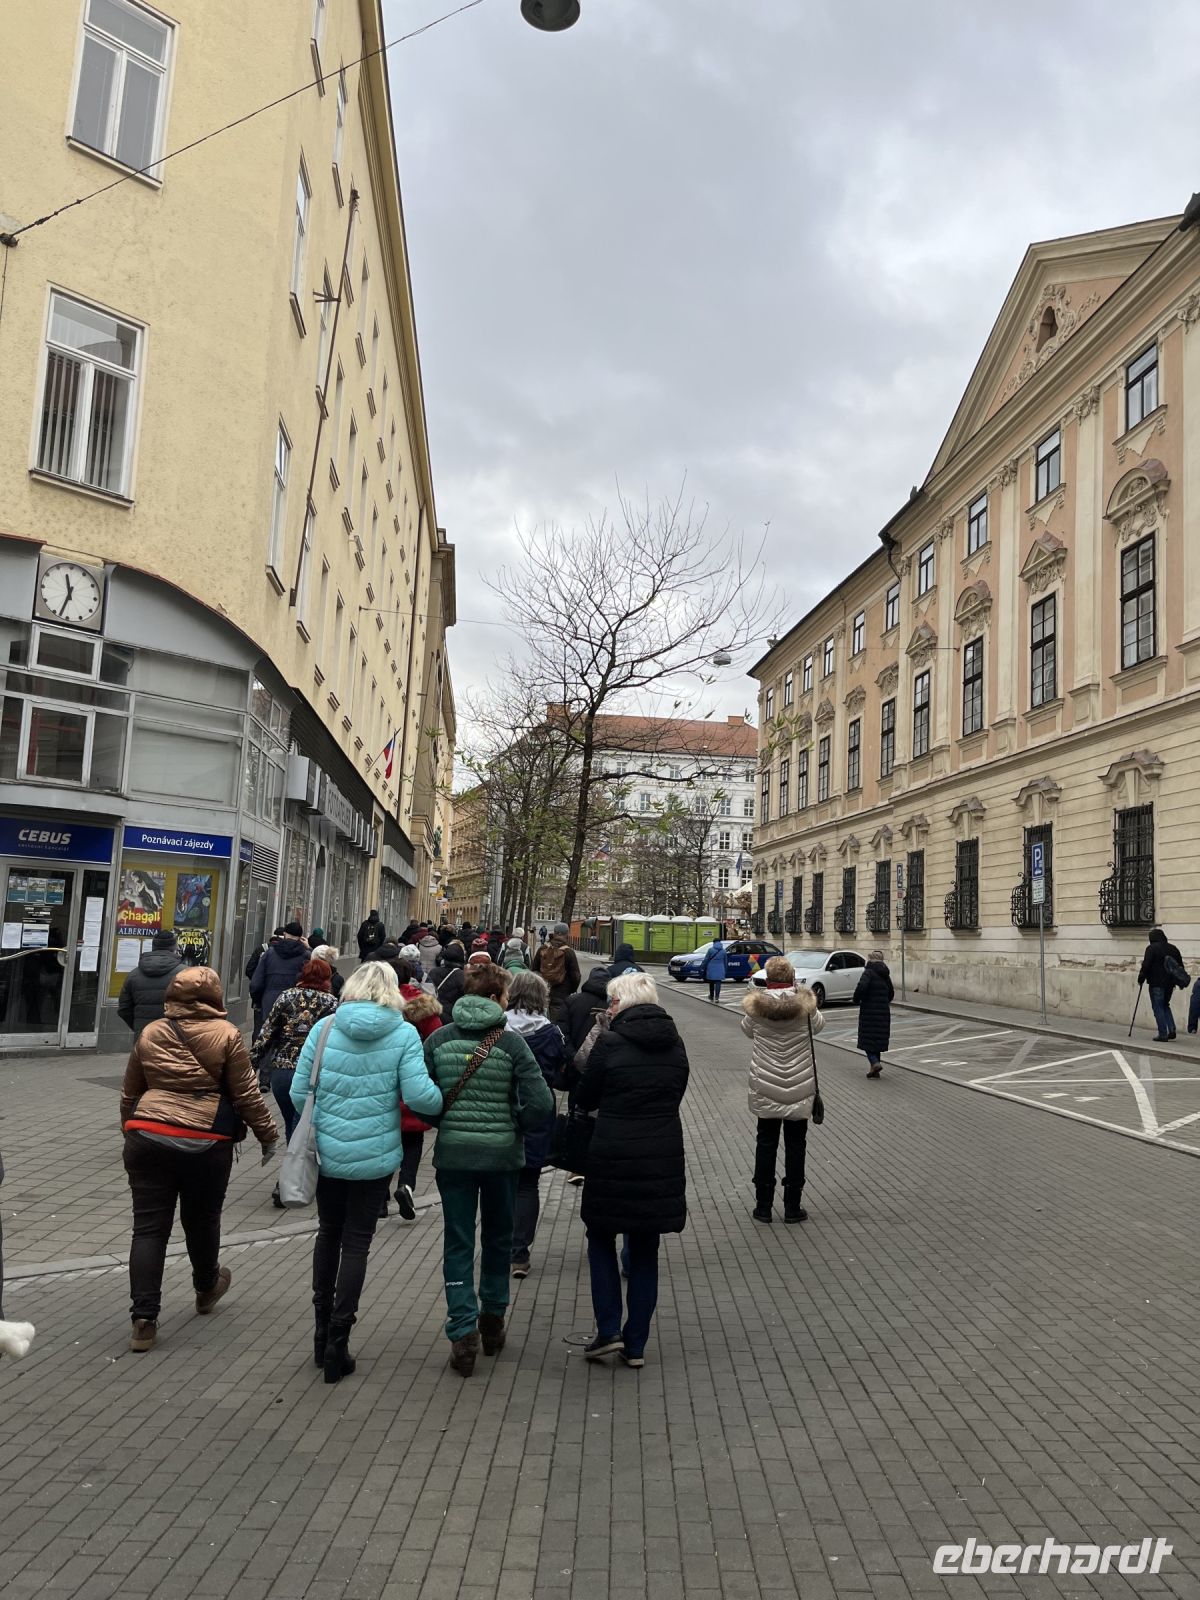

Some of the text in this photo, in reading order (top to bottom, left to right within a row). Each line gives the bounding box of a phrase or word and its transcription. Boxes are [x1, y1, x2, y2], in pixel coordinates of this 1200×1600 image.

[18, 829, 72, 845] CEBUS
[141, 834, 214, 851] Poznávací zájezdy
[1034, 848, 1042, 869] P
[121, 910, 160, 924] Chagall
[118, 927, 158, 936] ALBERTINA
